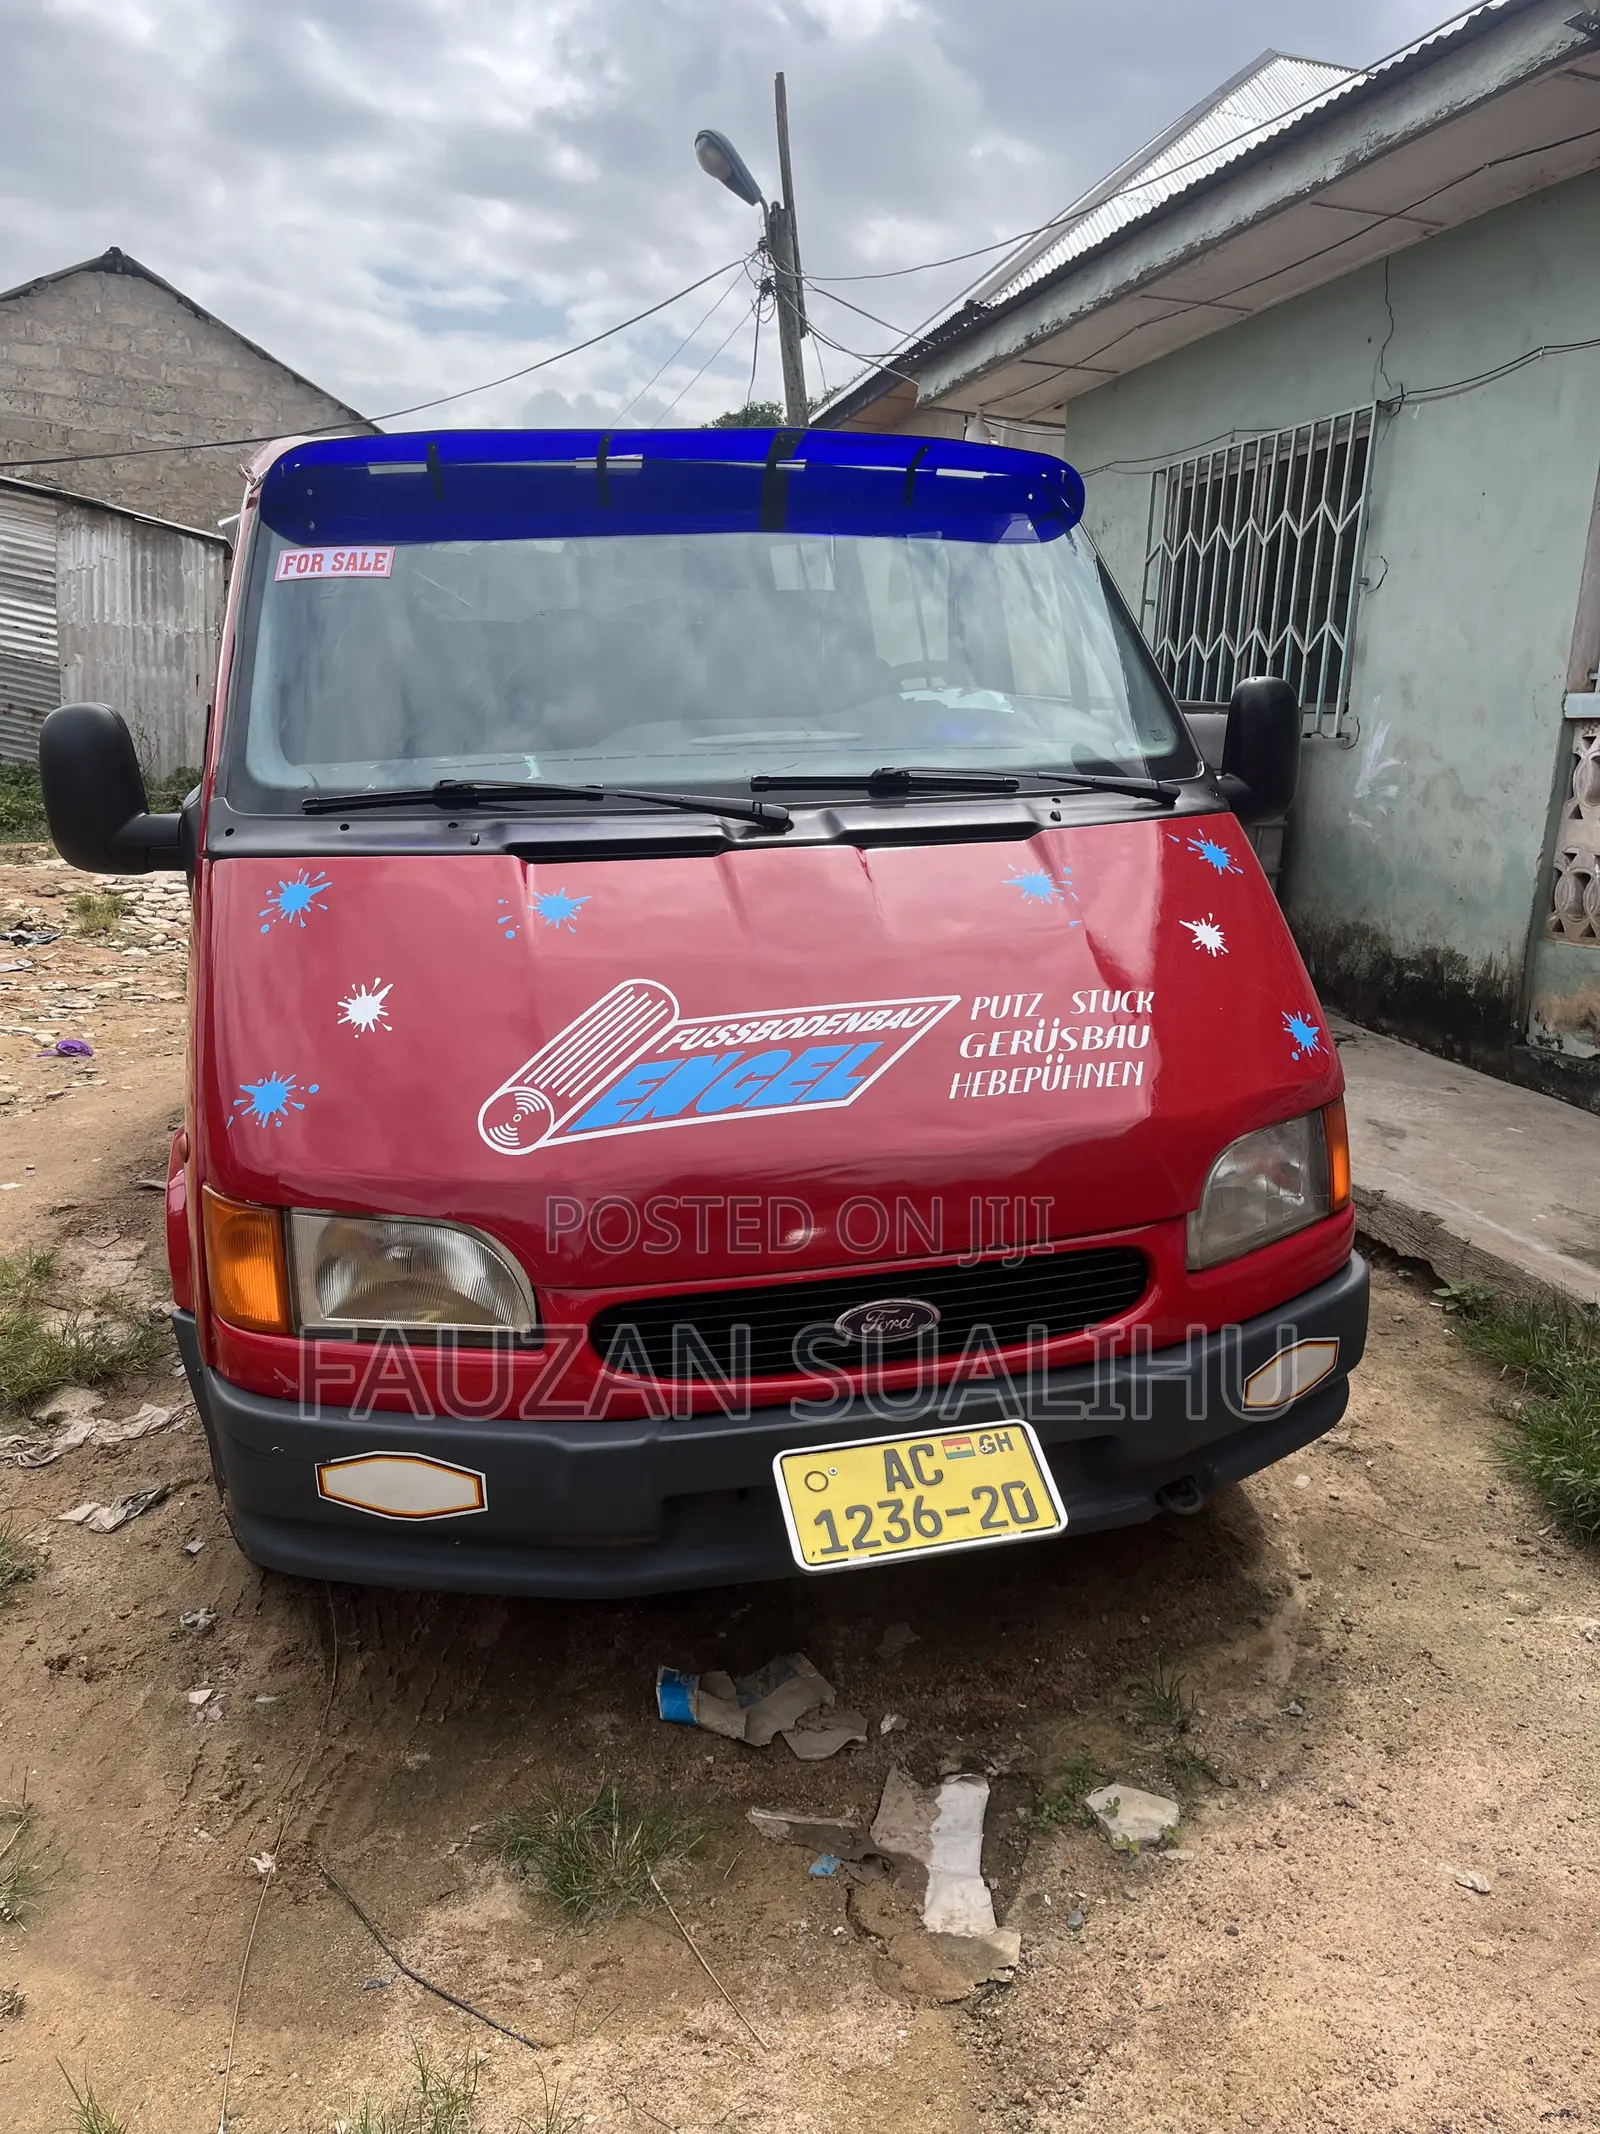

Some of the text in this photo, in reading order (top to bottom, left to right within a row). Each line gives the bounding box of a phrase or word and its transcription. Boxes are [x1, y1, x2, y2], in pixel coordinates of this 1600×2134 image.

[282, 552, 388, 575] FOR SALE
[970, 989, 1155, 1021] PUTZ STUCK
[656, 1005, 938, 1054] FUSSBODENBAU
[959, 1017, 1150, 1059] GERÜSBAU
[949, 1053, 1144, 1100] HEBEPÜHNEN
[860, 1308, 915, 1334] Ford
[883, 1431, 1014, 1492] AC GH
[813, 1480, 1039, 1555] 1236-20
